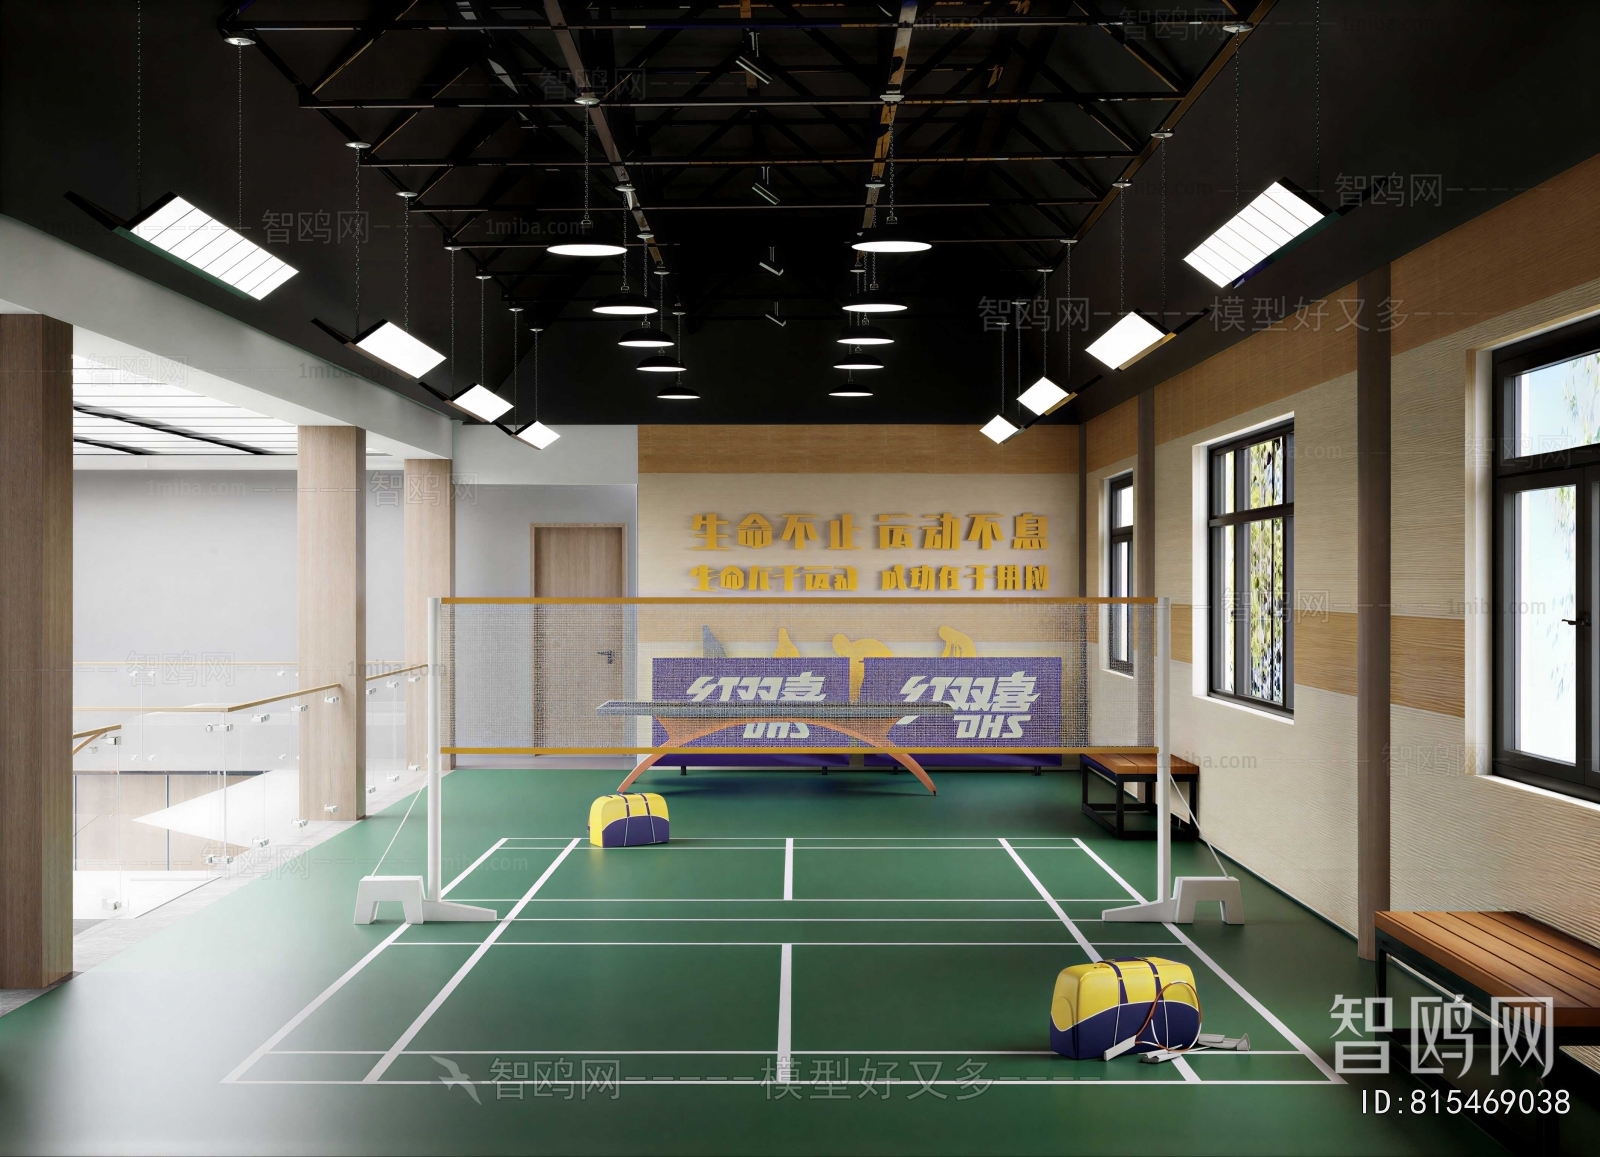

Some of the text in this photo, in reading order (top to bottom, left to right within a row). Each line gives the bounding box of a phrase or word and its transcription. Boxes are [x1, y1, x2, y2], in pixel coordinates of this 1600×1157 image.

[690, 513, 1049, 550] 生命不止 运动不息
[954, 715, 1032, 739] DHS
